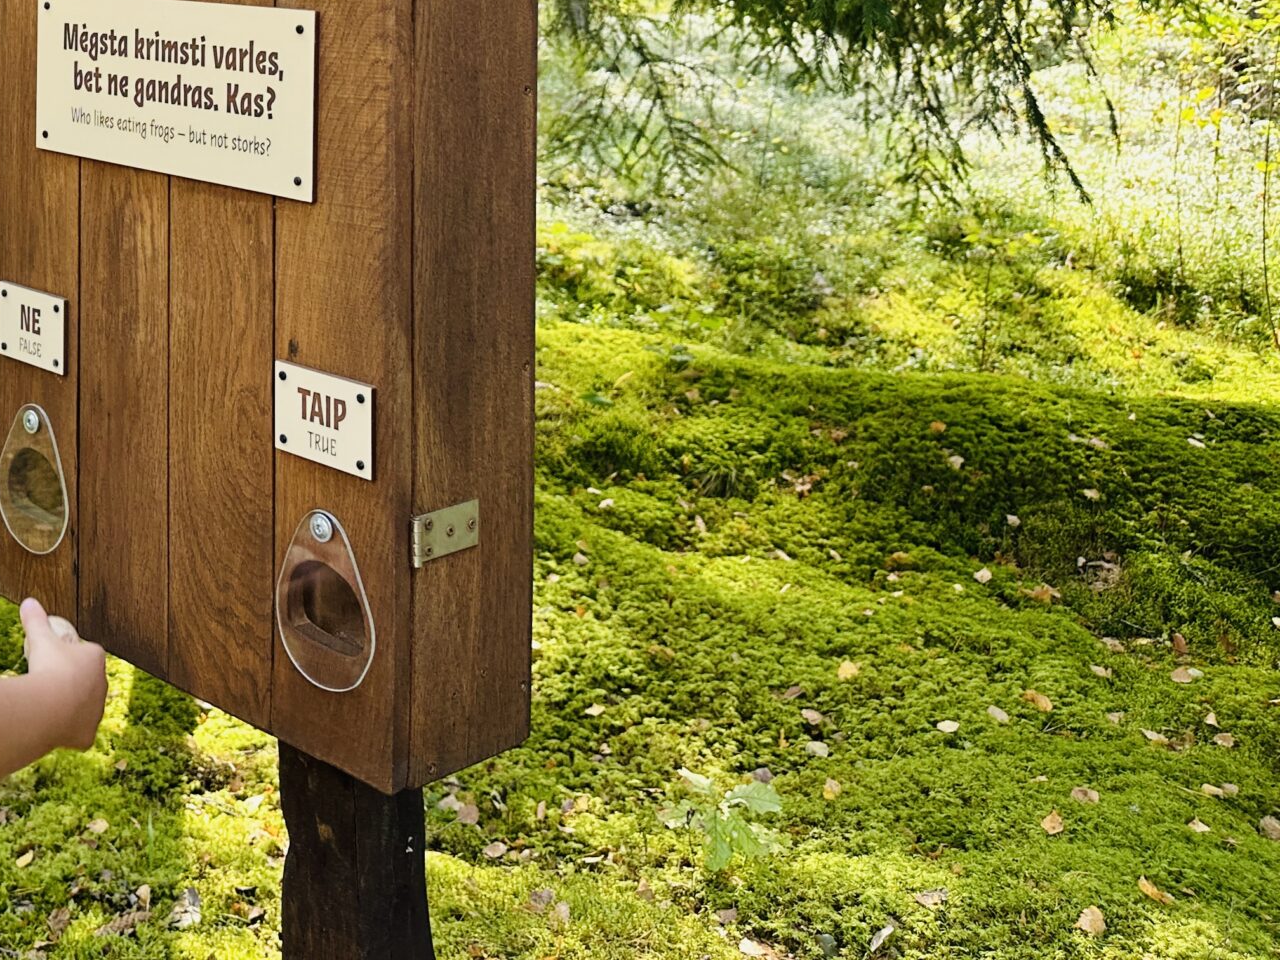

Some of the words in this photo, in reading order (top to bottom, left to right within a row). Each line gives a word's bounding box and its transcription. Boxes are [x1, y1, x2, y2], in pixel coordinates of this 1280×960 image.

[63, 23, 128, 61] Mėgsta
[134, 28, 206, 67] krimsti
[212, 40, 284, 82] varles,
[73, 61, 102, 92] bet
[107, 73, 128, 98] ne
[133, 74, 219, 111] gandras.
[226, 82, 276, 120] Kas?
[71, 106, 91, 125] Who
[93, 110, 114, 129] likes
[117, 115, 147, 139] eating
[150, 118, 175, 143] frogs
[189, 125, 207, 146] but
[210, 133, 228, 150] not
[231, 135, 272, 157] storks?
[20, 304, 41, 336] NE
[19, 337, 42, 358] FALSE
[297, 386, 347, 431] TAIP
[307, 430, 337, 457] TRUE
